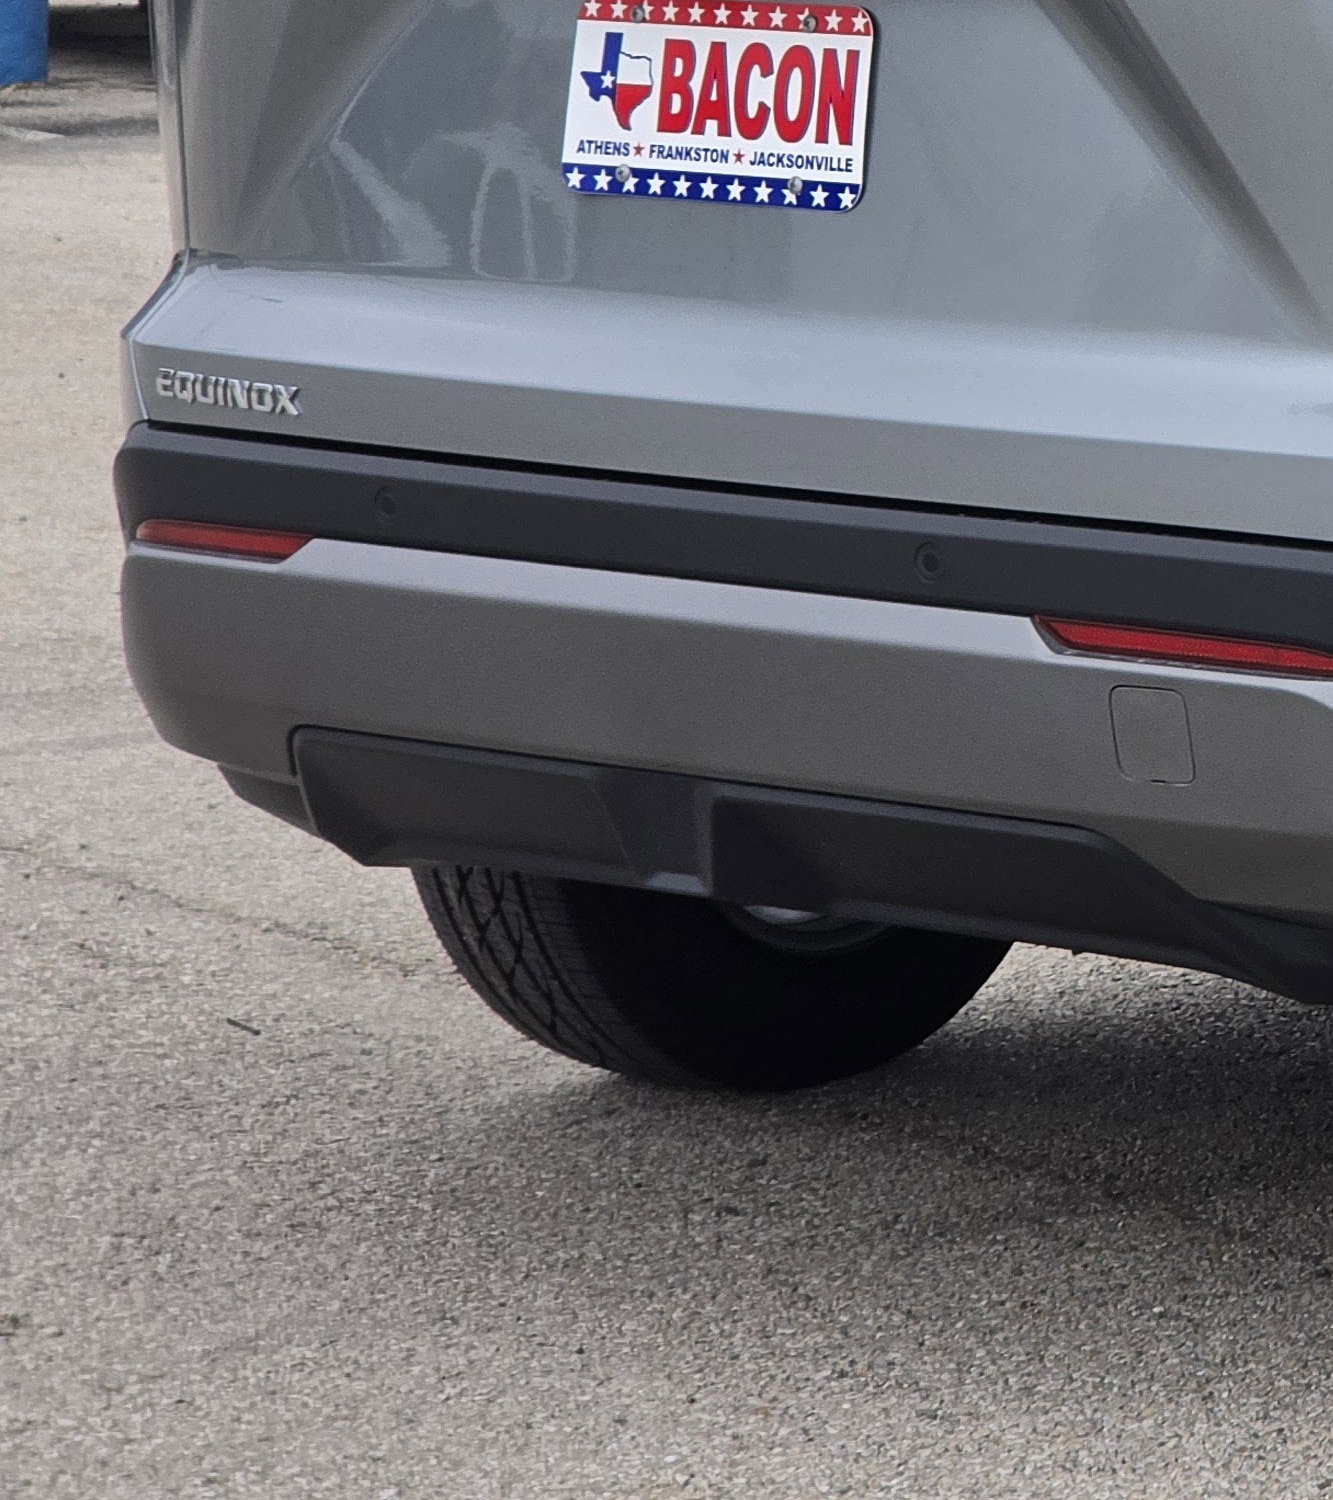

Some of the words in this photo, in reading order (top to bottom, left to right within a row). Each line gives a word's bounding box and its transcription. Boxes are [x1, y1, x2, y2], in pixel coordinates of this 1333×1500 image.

[656, 38, 860, 146] BACON
[576, 139, 630, 156] ATHENS
[649, 144, 729, 164] FRANKSTON
[749, 151, 854, 173] JACKSONVILLE
[155, 367, 300, 416] EQUINOX
